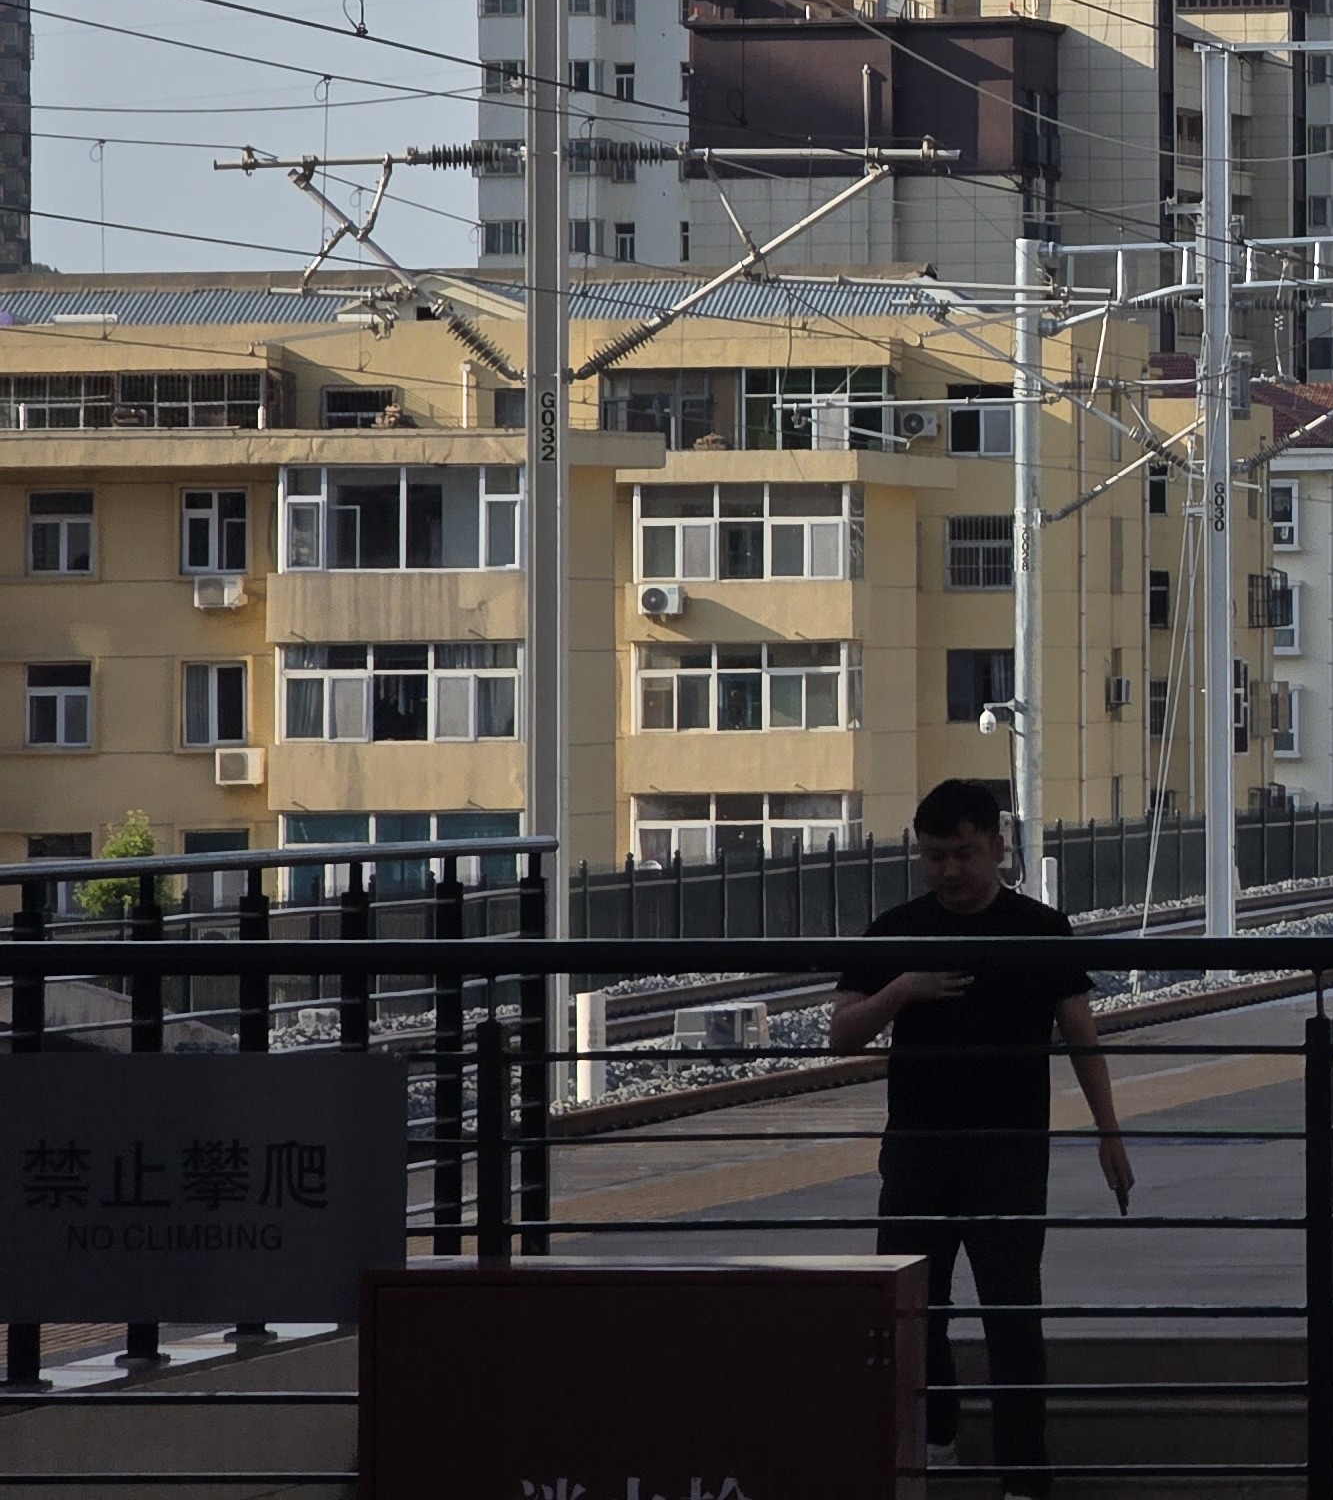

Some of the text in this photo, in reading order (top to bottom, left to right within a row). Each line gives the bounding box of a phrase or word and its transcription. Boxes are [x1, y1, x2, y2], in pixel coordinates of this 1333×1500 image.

[540, 391, 555, 461] G032
[1214, 482, 1225, 532] G030
[22, 1139, 328, 1211] 禁止攀爬
[67, 1223, 283, 1251] NO CLIMBING
